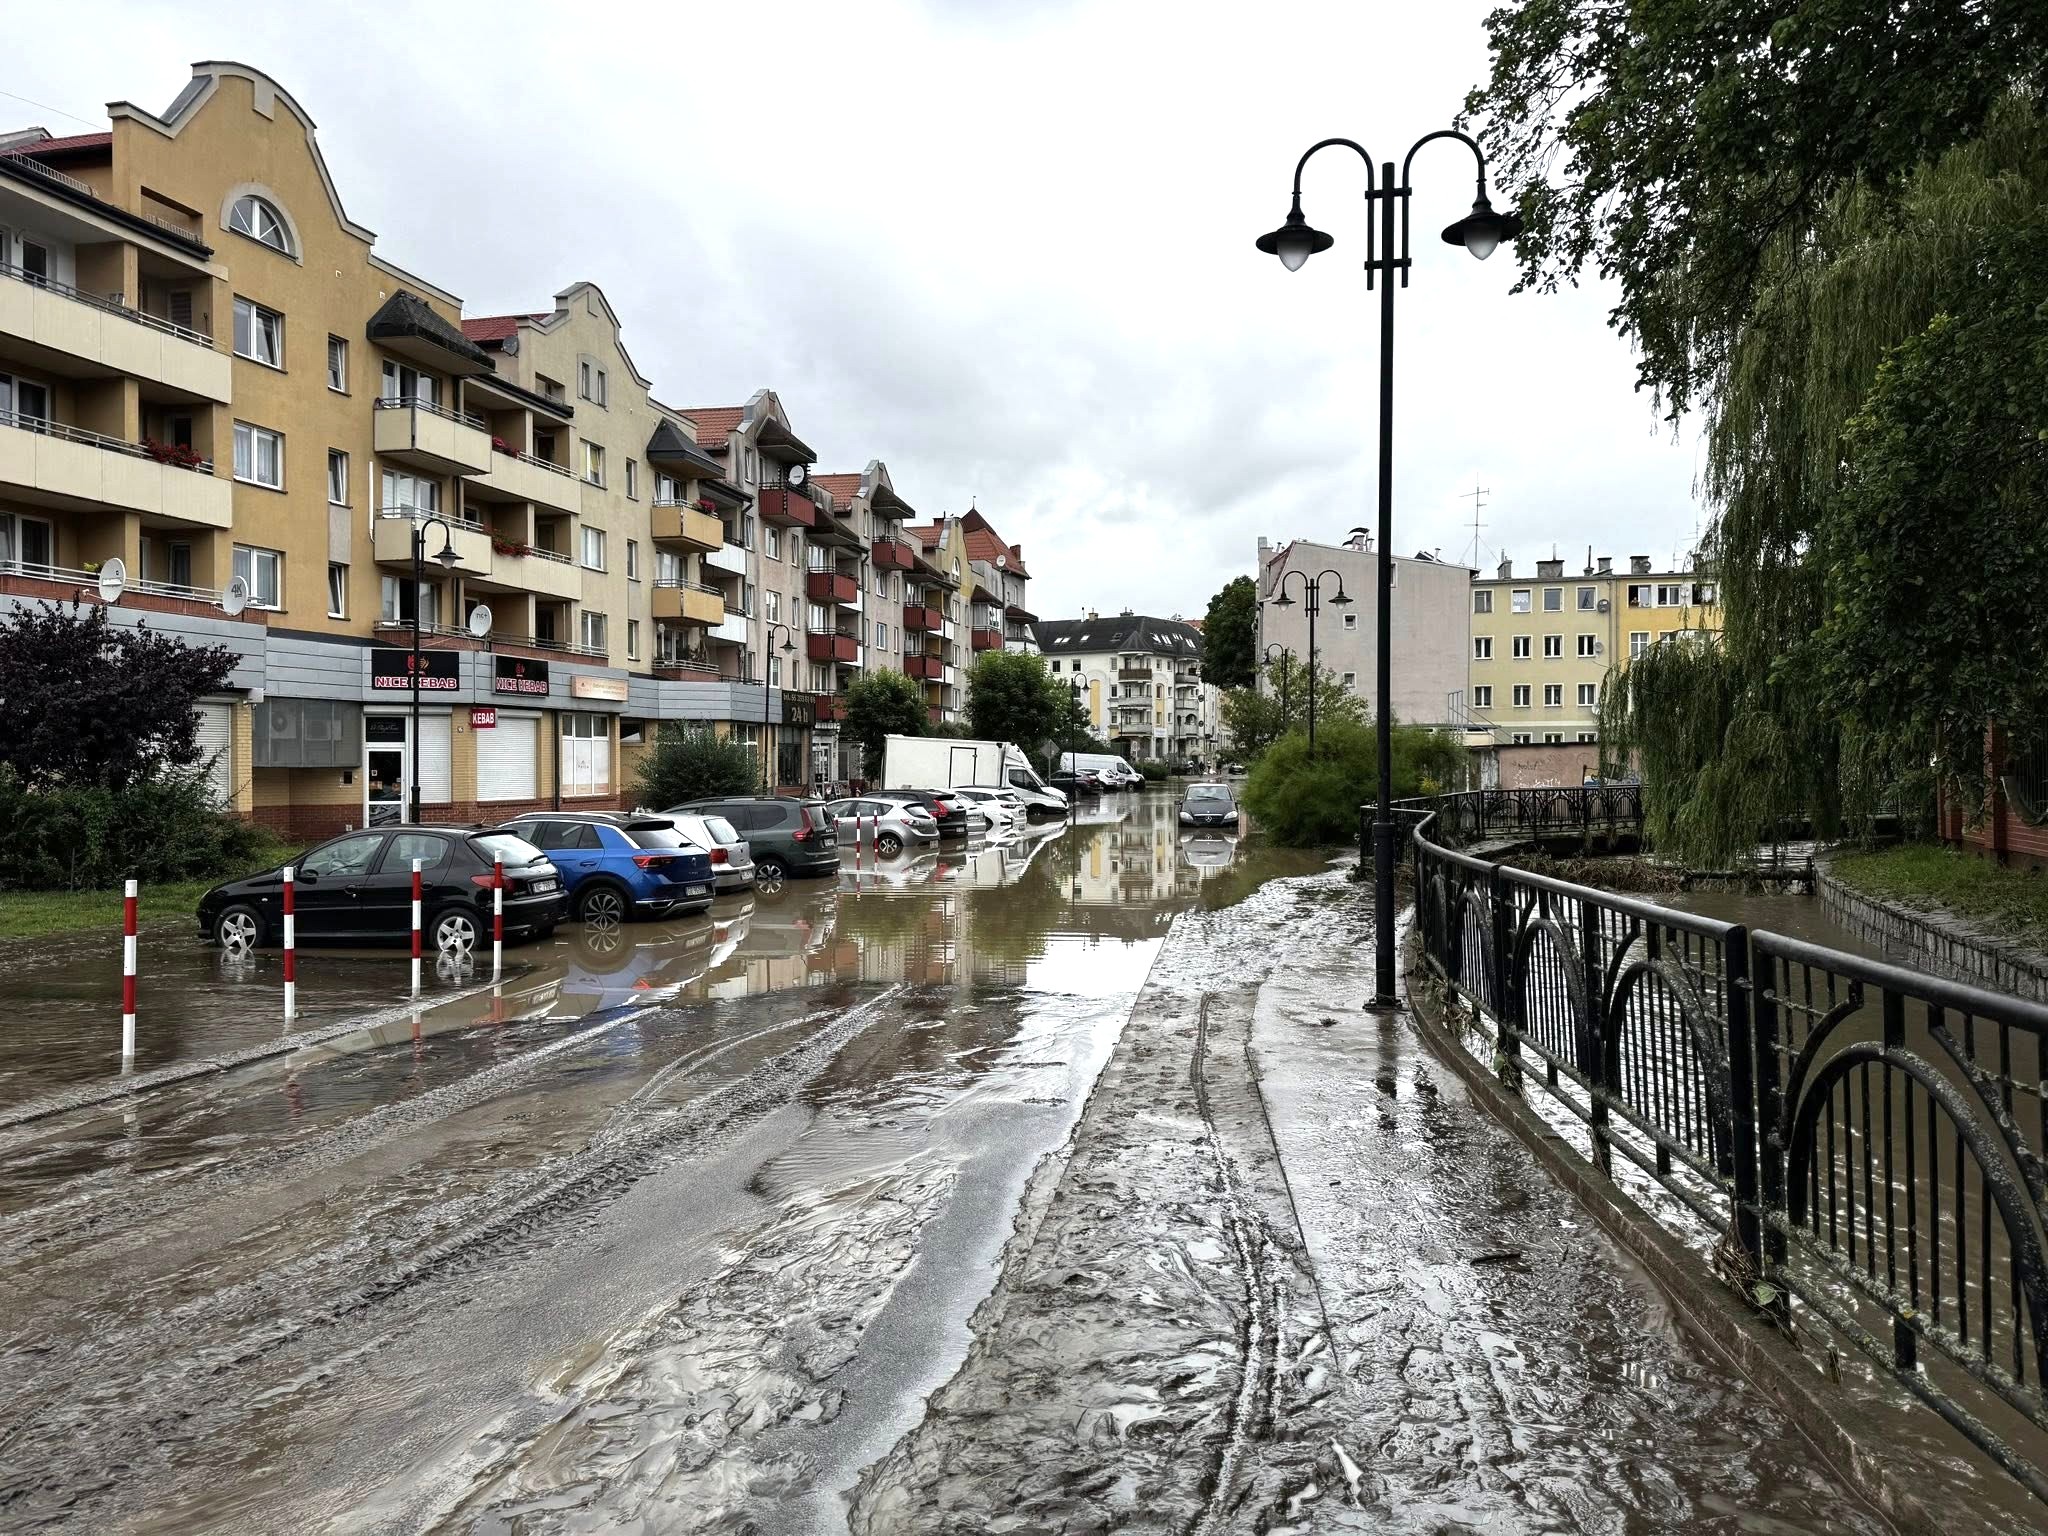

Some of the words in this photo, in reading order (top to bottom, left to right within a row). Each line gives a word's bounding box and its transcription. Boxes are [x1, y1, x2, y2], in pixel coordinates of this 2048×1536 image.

[375, 676, 408, 688] NICE
[496, 677, 517, 691] NICE
[518, 679, 548, 693] KEBAB
[472, 712, 495, 725] KEBAB
[792, 707, 802, 722] 24
[803, 707, 808, 722] h
